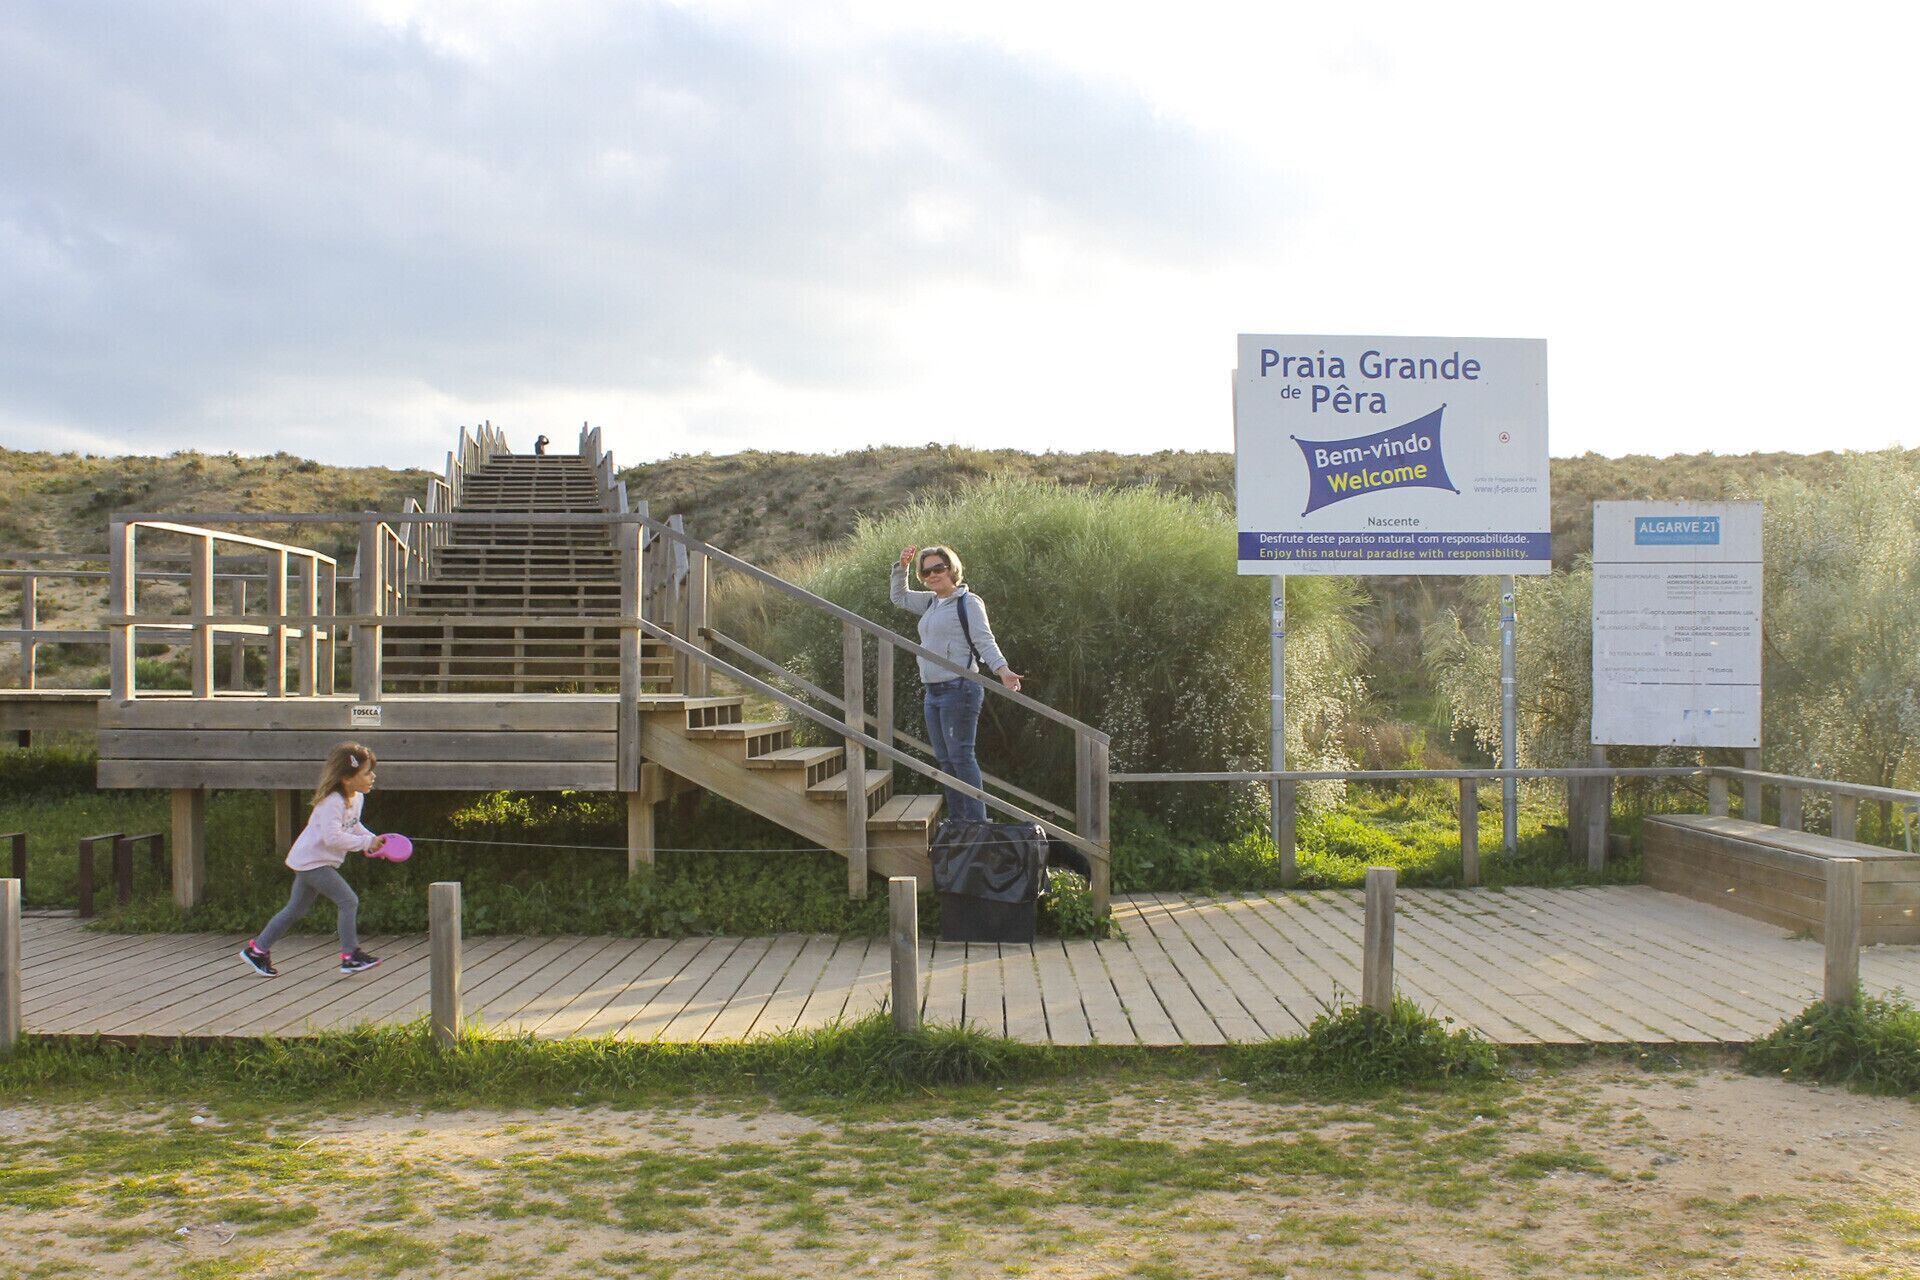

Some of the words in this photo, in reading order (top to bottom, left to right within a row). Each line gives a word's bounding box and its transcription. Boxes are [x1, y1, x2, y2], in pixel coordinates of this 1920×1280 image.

[1261, 349, 1346, 378] Praia
[1359, 350, 1481, 380] Grande
[1280, 385, 1302, 399] de
[1312, 384, 1387, 414] Pêra
[1314, 433, 1432, 468] Bem-vindo
[1327, 464, 1428, 493] Welcome
[1474, 485, 1537, 494] www.jf-pera.com
[1367, 517, 1420, 527] Nascente
[1639, 521, 1700, 533] ALGARVE
[1702, 521, 1716, 533] 21
[1260, 533, 1304, 544] Desfrute
[1306, 533, 1335, 544] deste
[1378, 533, 1415, 544] natural
[1417, 535, 1439, 544] com
[1442, 533, 1530, 546] responsabilidade.
[1260, 548, 1292, 559] Enjoy
[1296, 548, 1318, 558] this
[1321, 548, 1363, 558] natural
[1366, 548, 1415, 559] paradise
[1418, 548, 1444, 558] with
[1447, 548, 1529, 560] responsibility.
